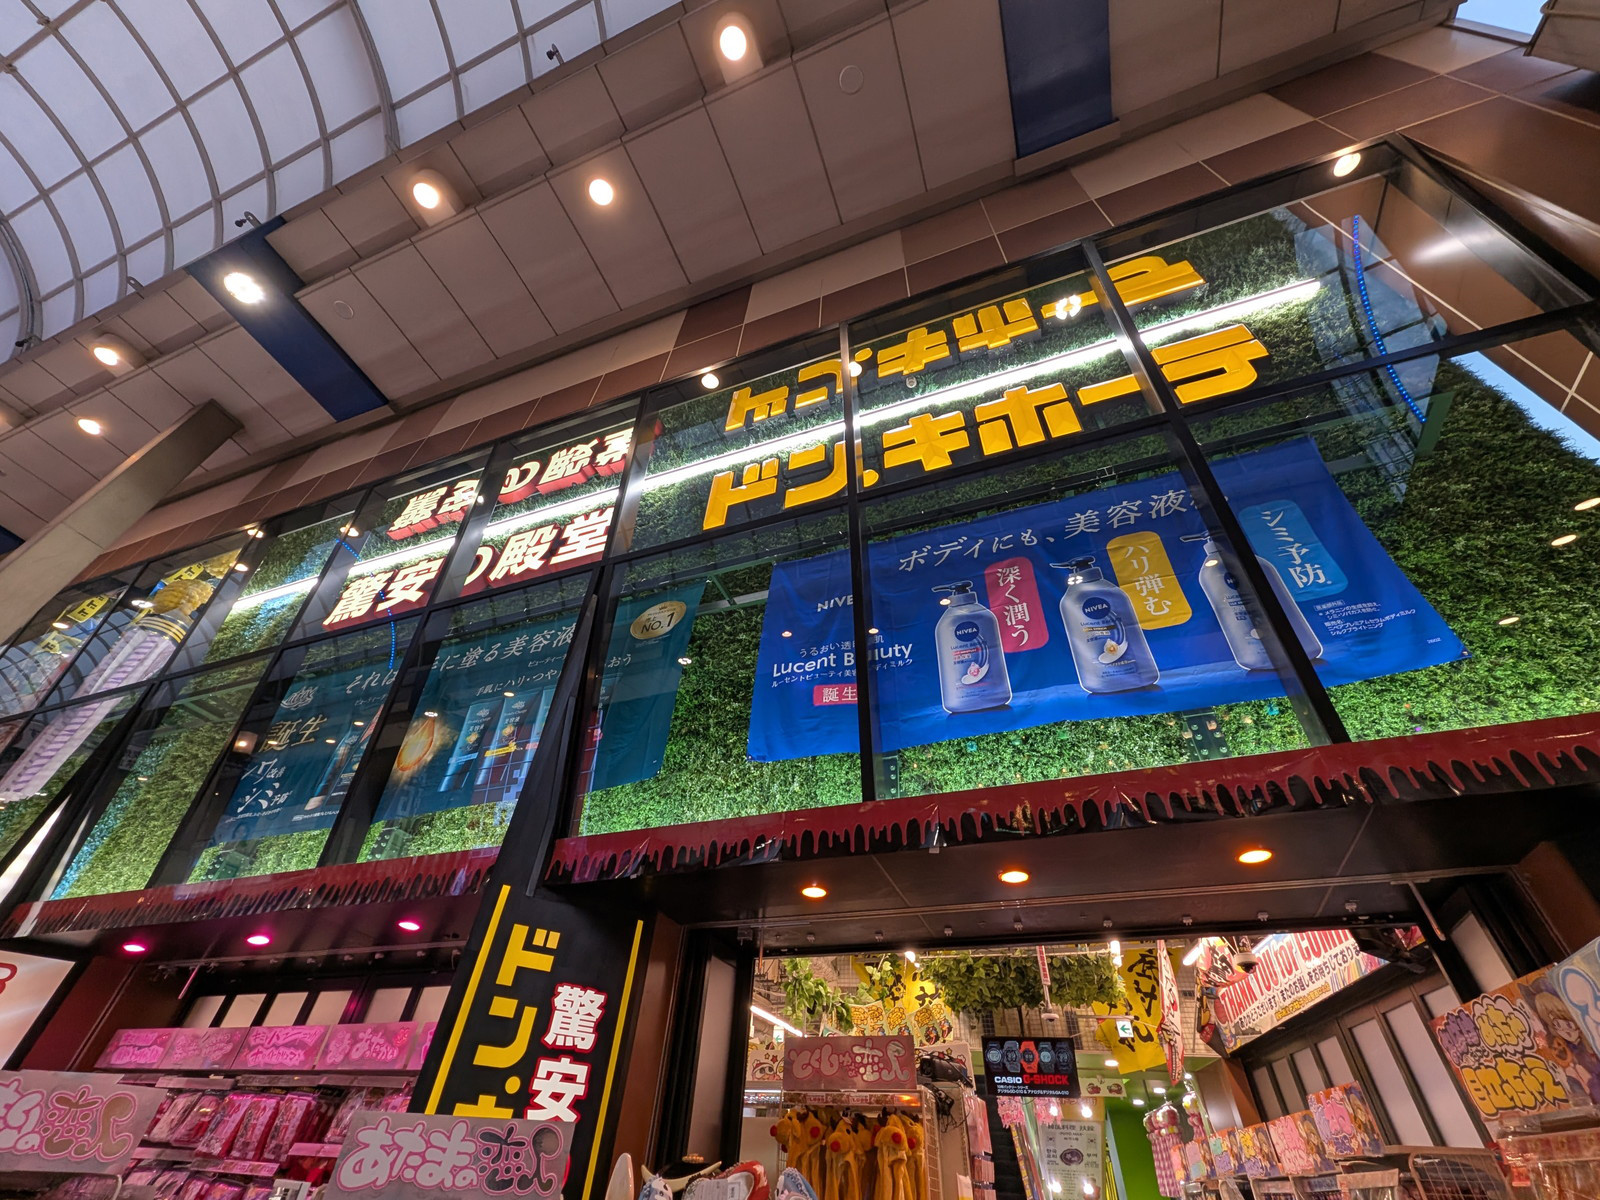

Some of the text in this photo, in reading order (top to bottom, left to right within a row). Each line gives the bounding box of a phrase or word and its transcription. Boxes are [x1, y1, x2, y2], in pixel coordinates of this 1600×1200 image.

[1124, 545, 1172, 615] ハリ弾む
[817, 594, 854, 612] NIVE
[996, 566, 1029, 647] 深く潤う
[1084, 603, 1108, 613] NIVEA
[641, 612, 675, 634] NO.1
[956, 627, 977, 636] NIVEA
[431, 623, 576, 672] に塗る美容液
[773, 652, 837, 677] Lucent
[822, 686, 857, 702] 誕生
[1219, 974, 1259, 1026] THANK
[994, 1074, 1069, 1085] CASIO G-SHOCK
